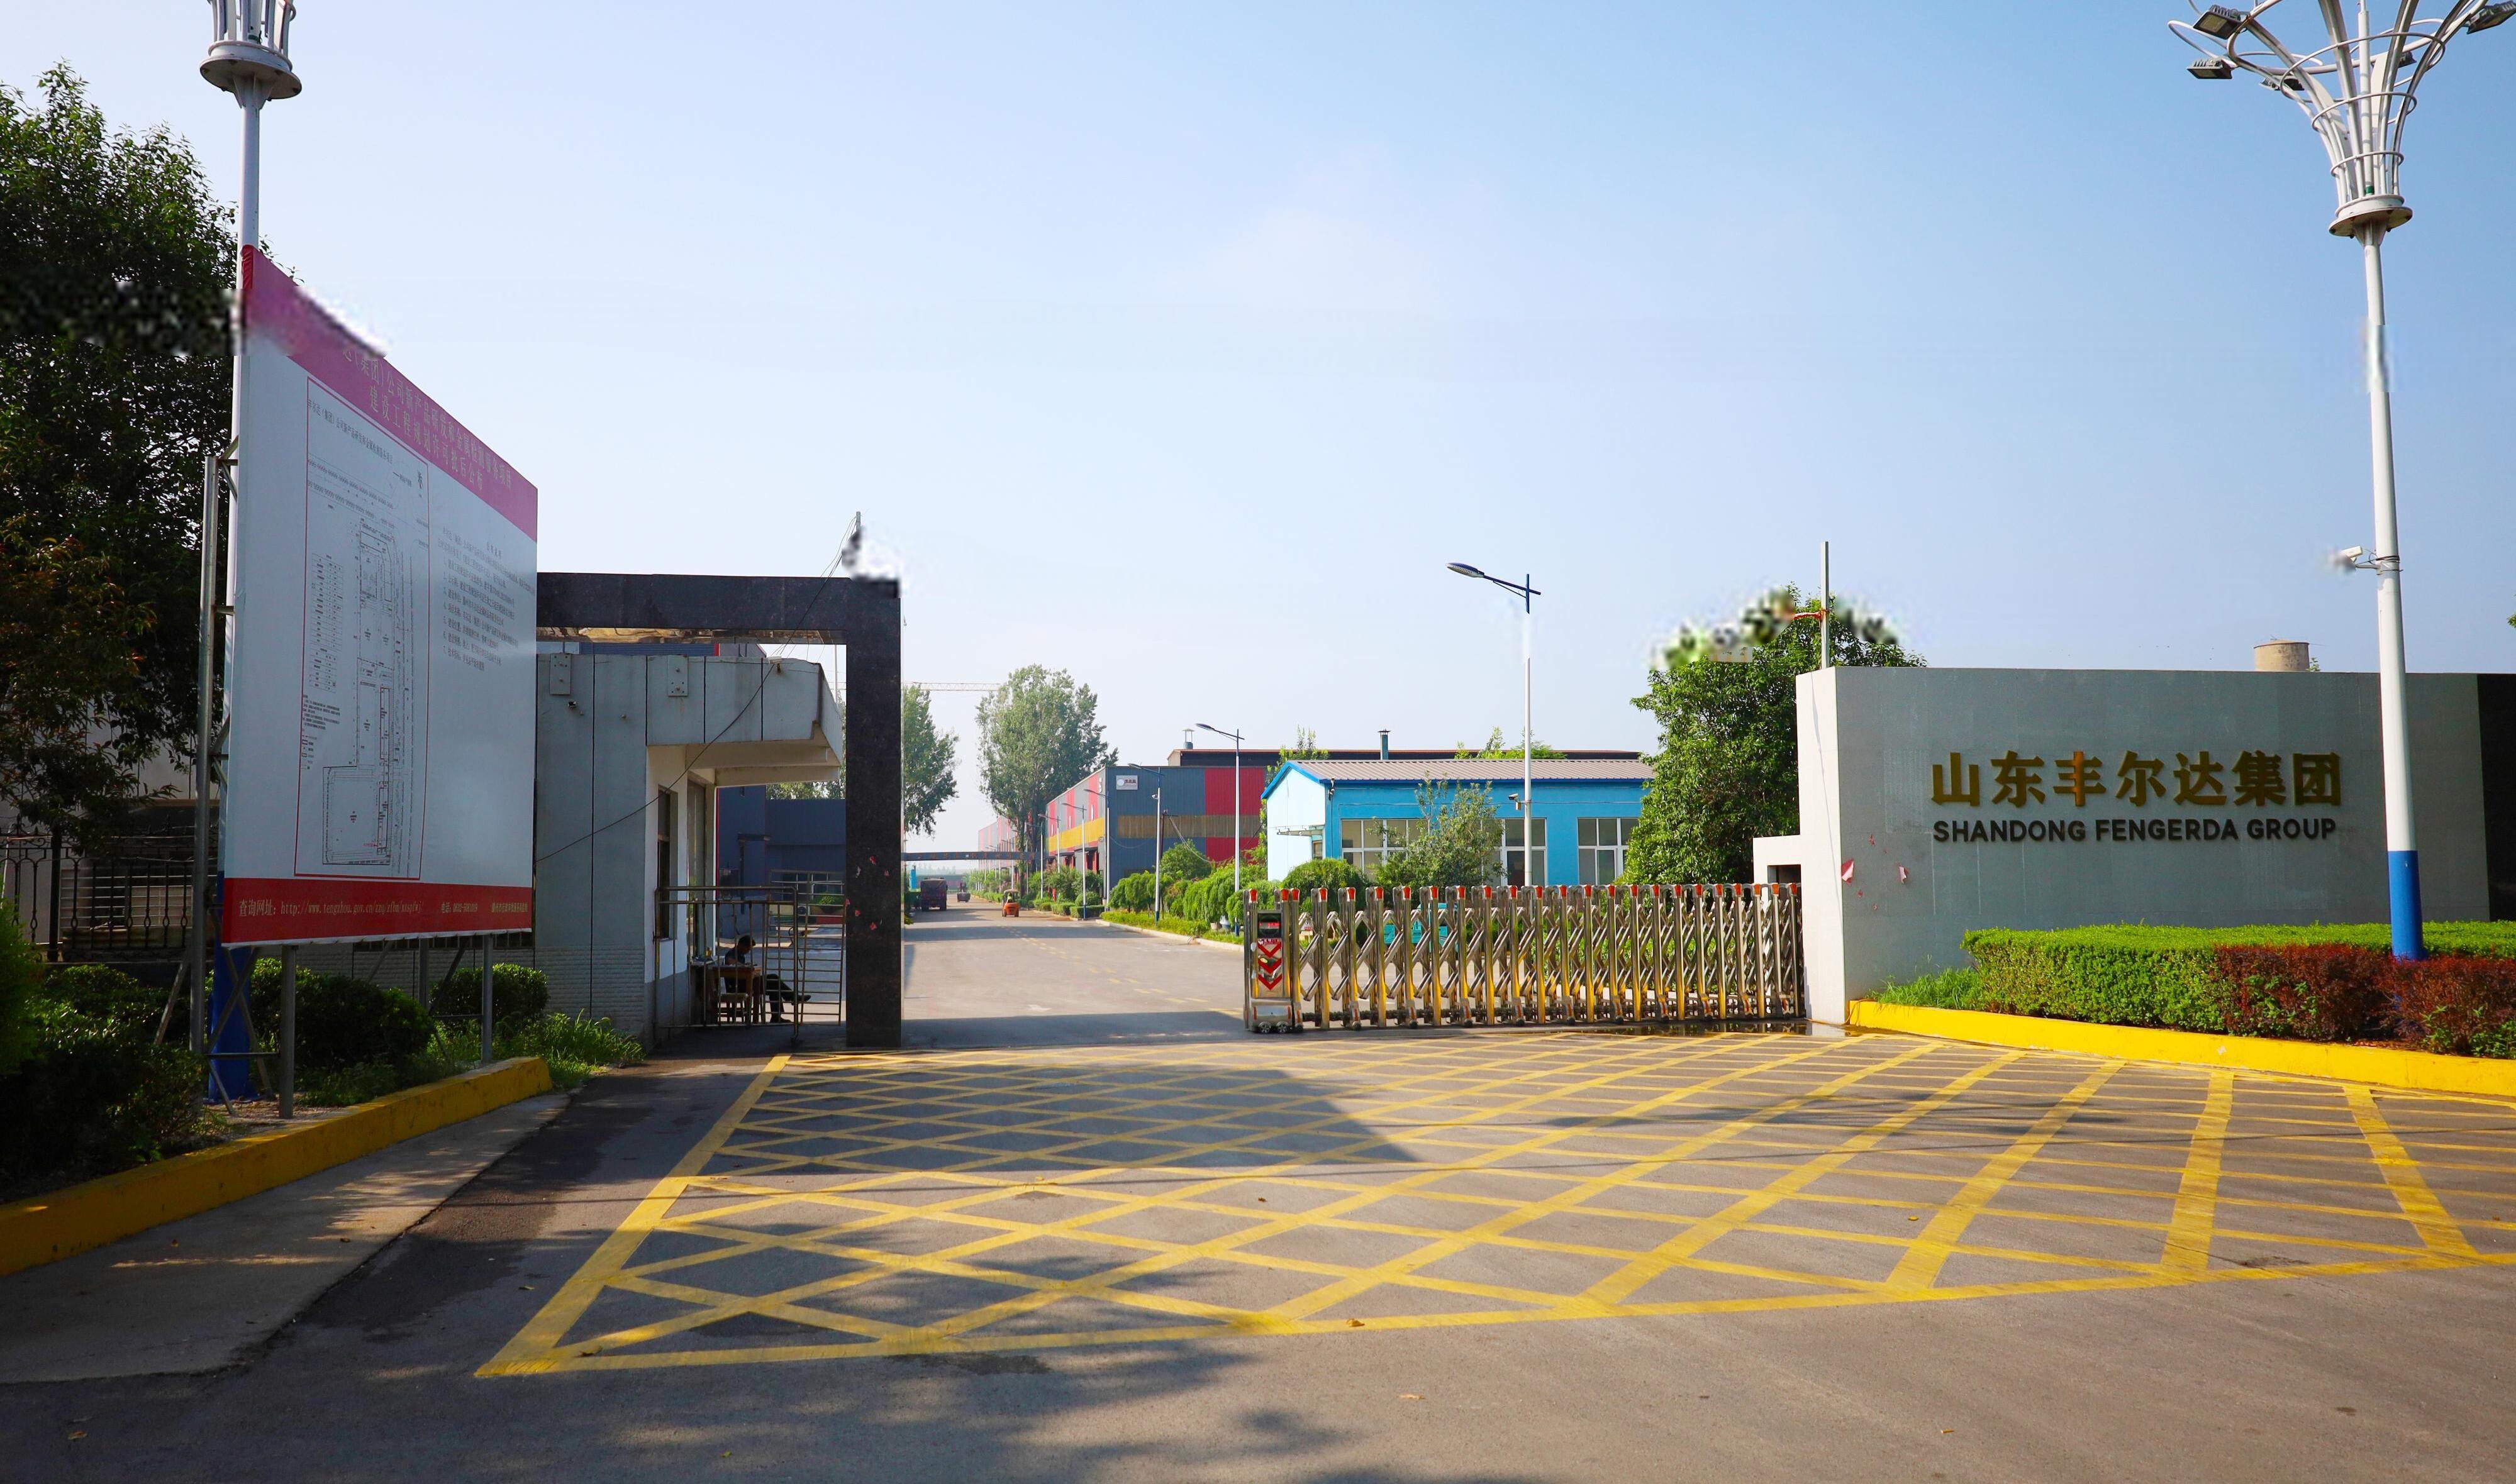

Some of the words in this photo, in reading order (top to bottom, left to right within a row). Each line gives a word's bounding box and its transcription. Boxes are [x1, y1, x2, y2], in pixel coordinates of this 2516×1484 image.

[1931, 750, 2342, 807] 山东丰尔达集团
[1933, 819, 2086, 843] SHANDONG
[2095, 818, 2238, 841] FENGERDA
[2246, 817, 2336, 839] GROUP
